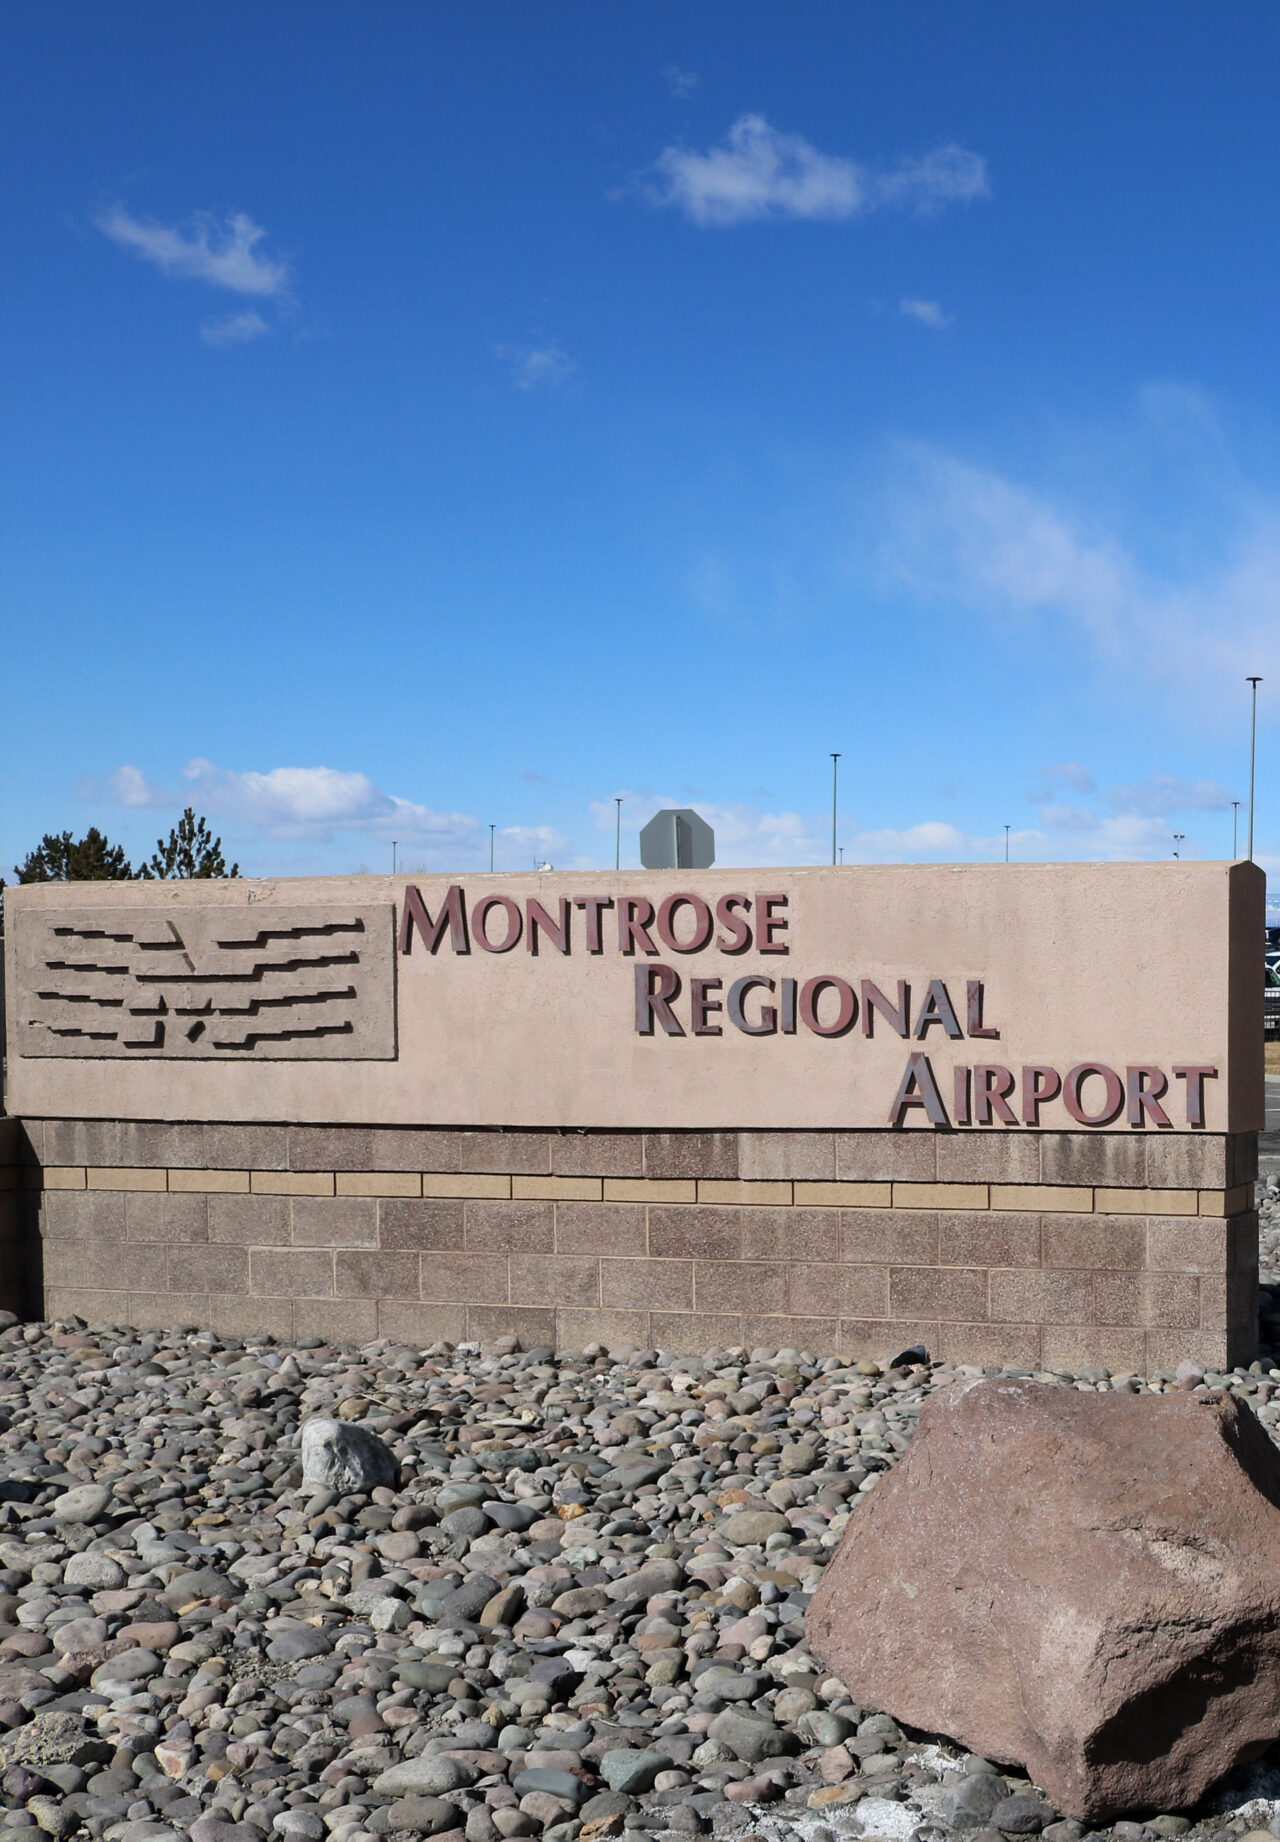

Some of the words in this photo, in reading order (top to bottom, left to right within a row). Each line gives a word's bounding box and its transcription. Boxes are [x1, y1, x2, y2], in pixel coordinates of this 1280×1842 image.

[398, 885, 788, 955] MONTROSE
[634, 963, 998, 1038] REGIONAL
[888, 1052, 1217, 1127] AIRPORT
